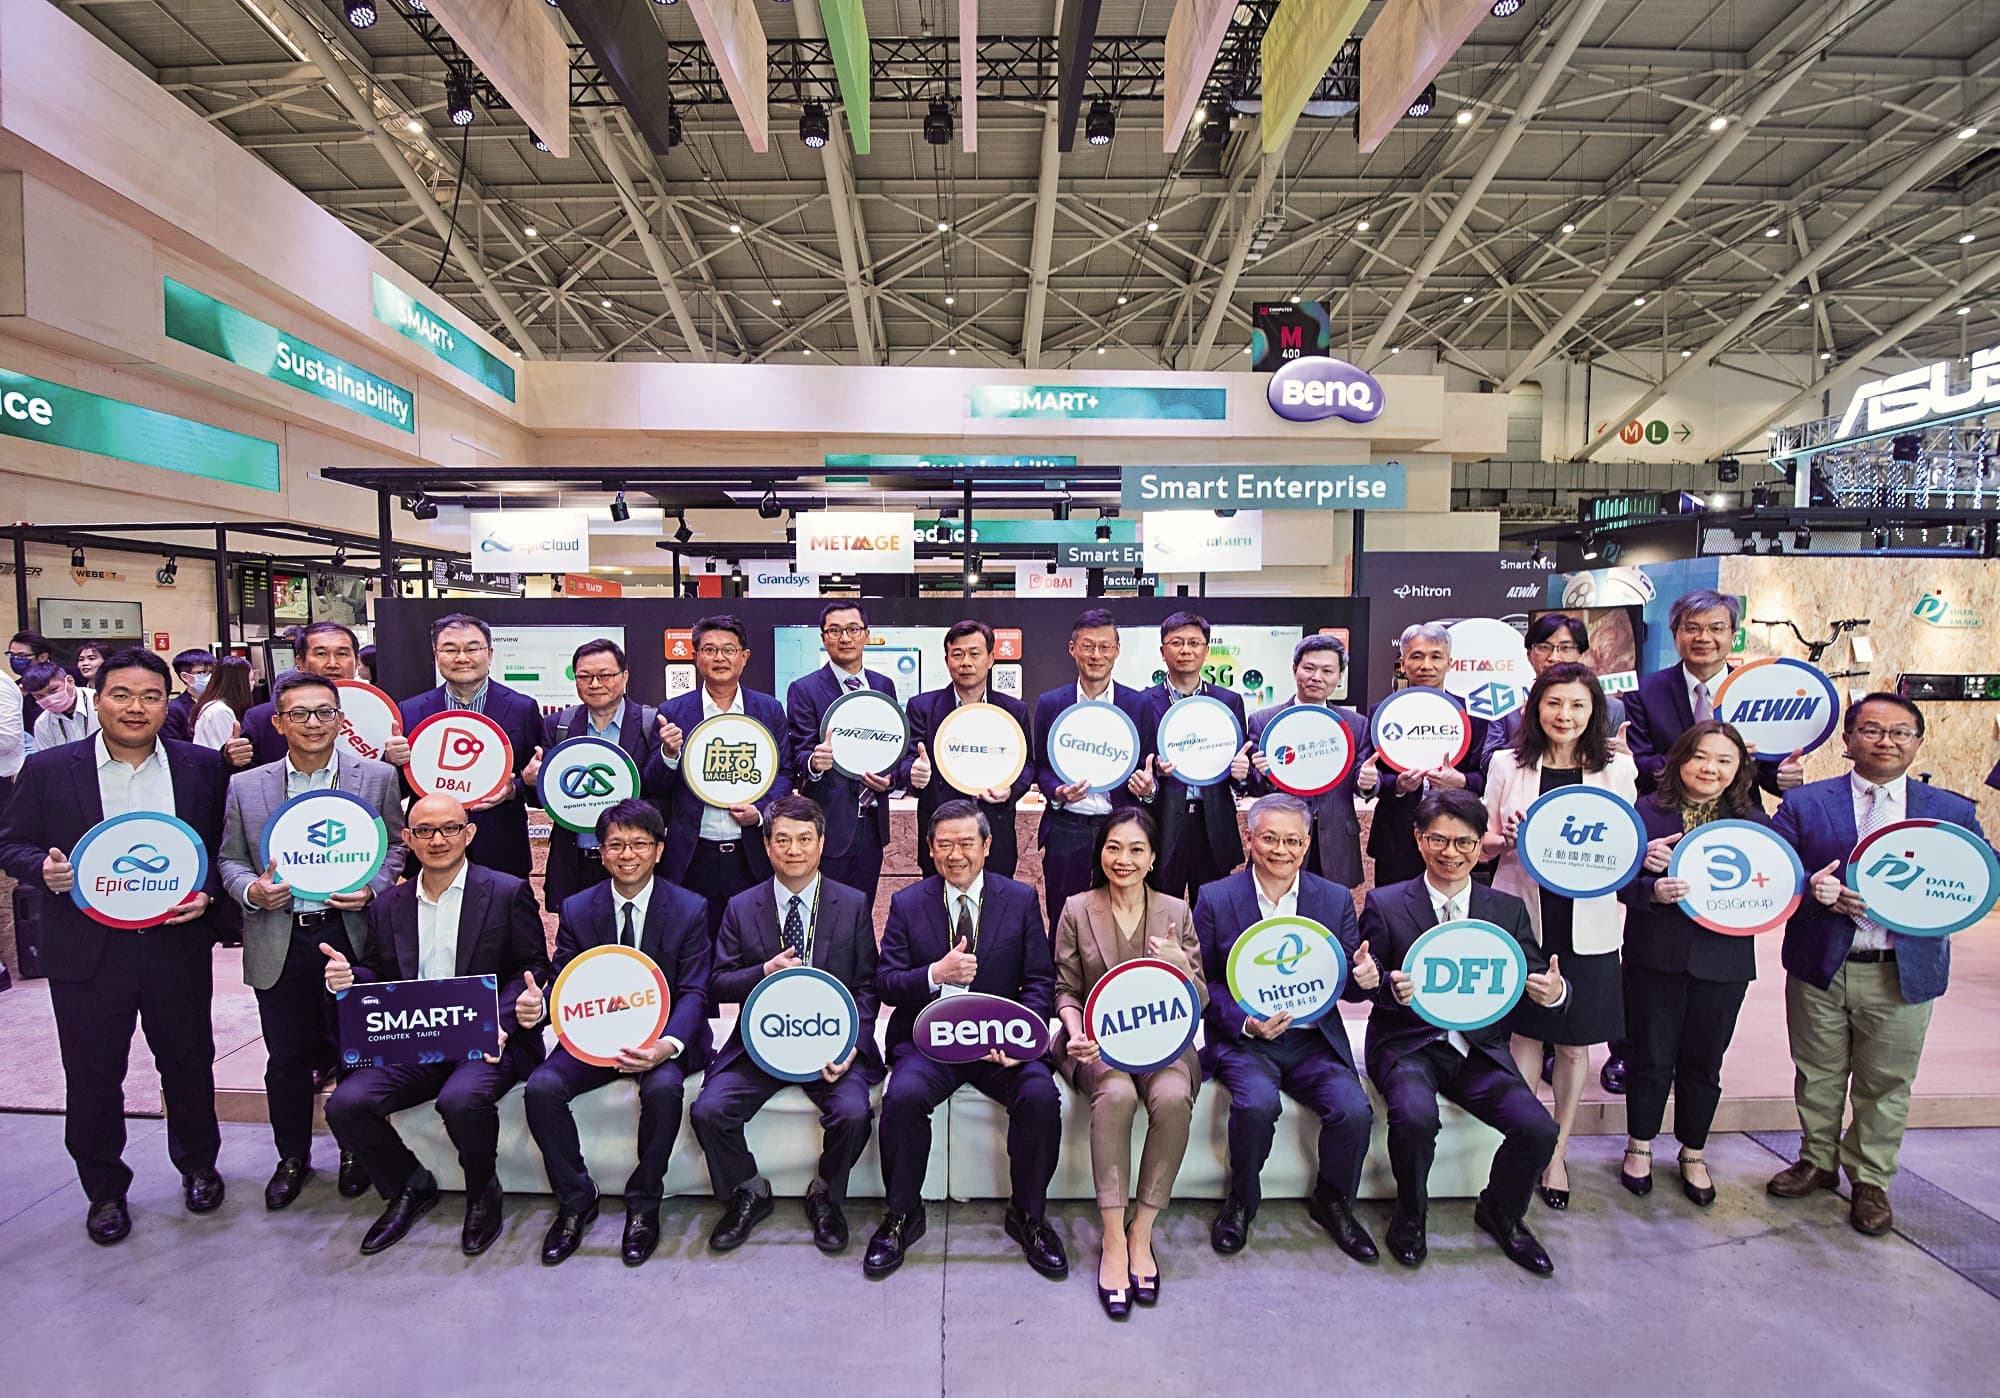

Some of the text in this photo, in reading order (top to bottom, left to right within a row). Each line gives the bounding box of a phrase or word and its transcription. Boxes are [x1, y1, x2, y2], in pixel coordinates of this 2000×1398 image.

[396, 300, 455, 352] SMART+
[1281, 326, 1302, 348] M
[1281, 348, 1301, 359] 400
[276, 343, 410, 423] Sustainability
[1006, 390, 1099, 412] SMART+
[1281, 379, 1374, 412] BenQ
[0, 390, 53, 428] ce
[1624, 423, 1662, 441] M L
[1140, 473, 1387, 508] Smart Enterprise
[1068, 547, 1119, 562] Smart
[1500, 559, 1531, 569] Smart
[757, 573, 810, 587] Grandsys
[1411, 584, 1452, 597] hitron
[1200, 664, 1234, 688] SG
[1730, 688, 1825, 723] AEWIN
[1407, 724, 1459, 736] APLEX
[1059, 733, 1130, 761] Grandsys
[435, 776, 472, 793] D8AI
[563, 802, 587, 810] epoint
[282, 848, 371, 867] MetaGuru
[1925, 876, 1966, 891] DATA
[1706, 897, 1774, 913] DSIGroup
[1924, 888, 1977, 904] IMAGE
[1422, 957, 1507, 995] DFI
[1258, 978, 1325, 1003] hitron
[366, 1005, 478, 1033] SMART+
[759, 1012, 841, 1038] Qisda
[1100, 996, 1188, 1037] ALPHA
[367, 1030, 441, 1042] COMPUTEX TAIPEI
[929, 1019, 1037, 1049] BenQ
